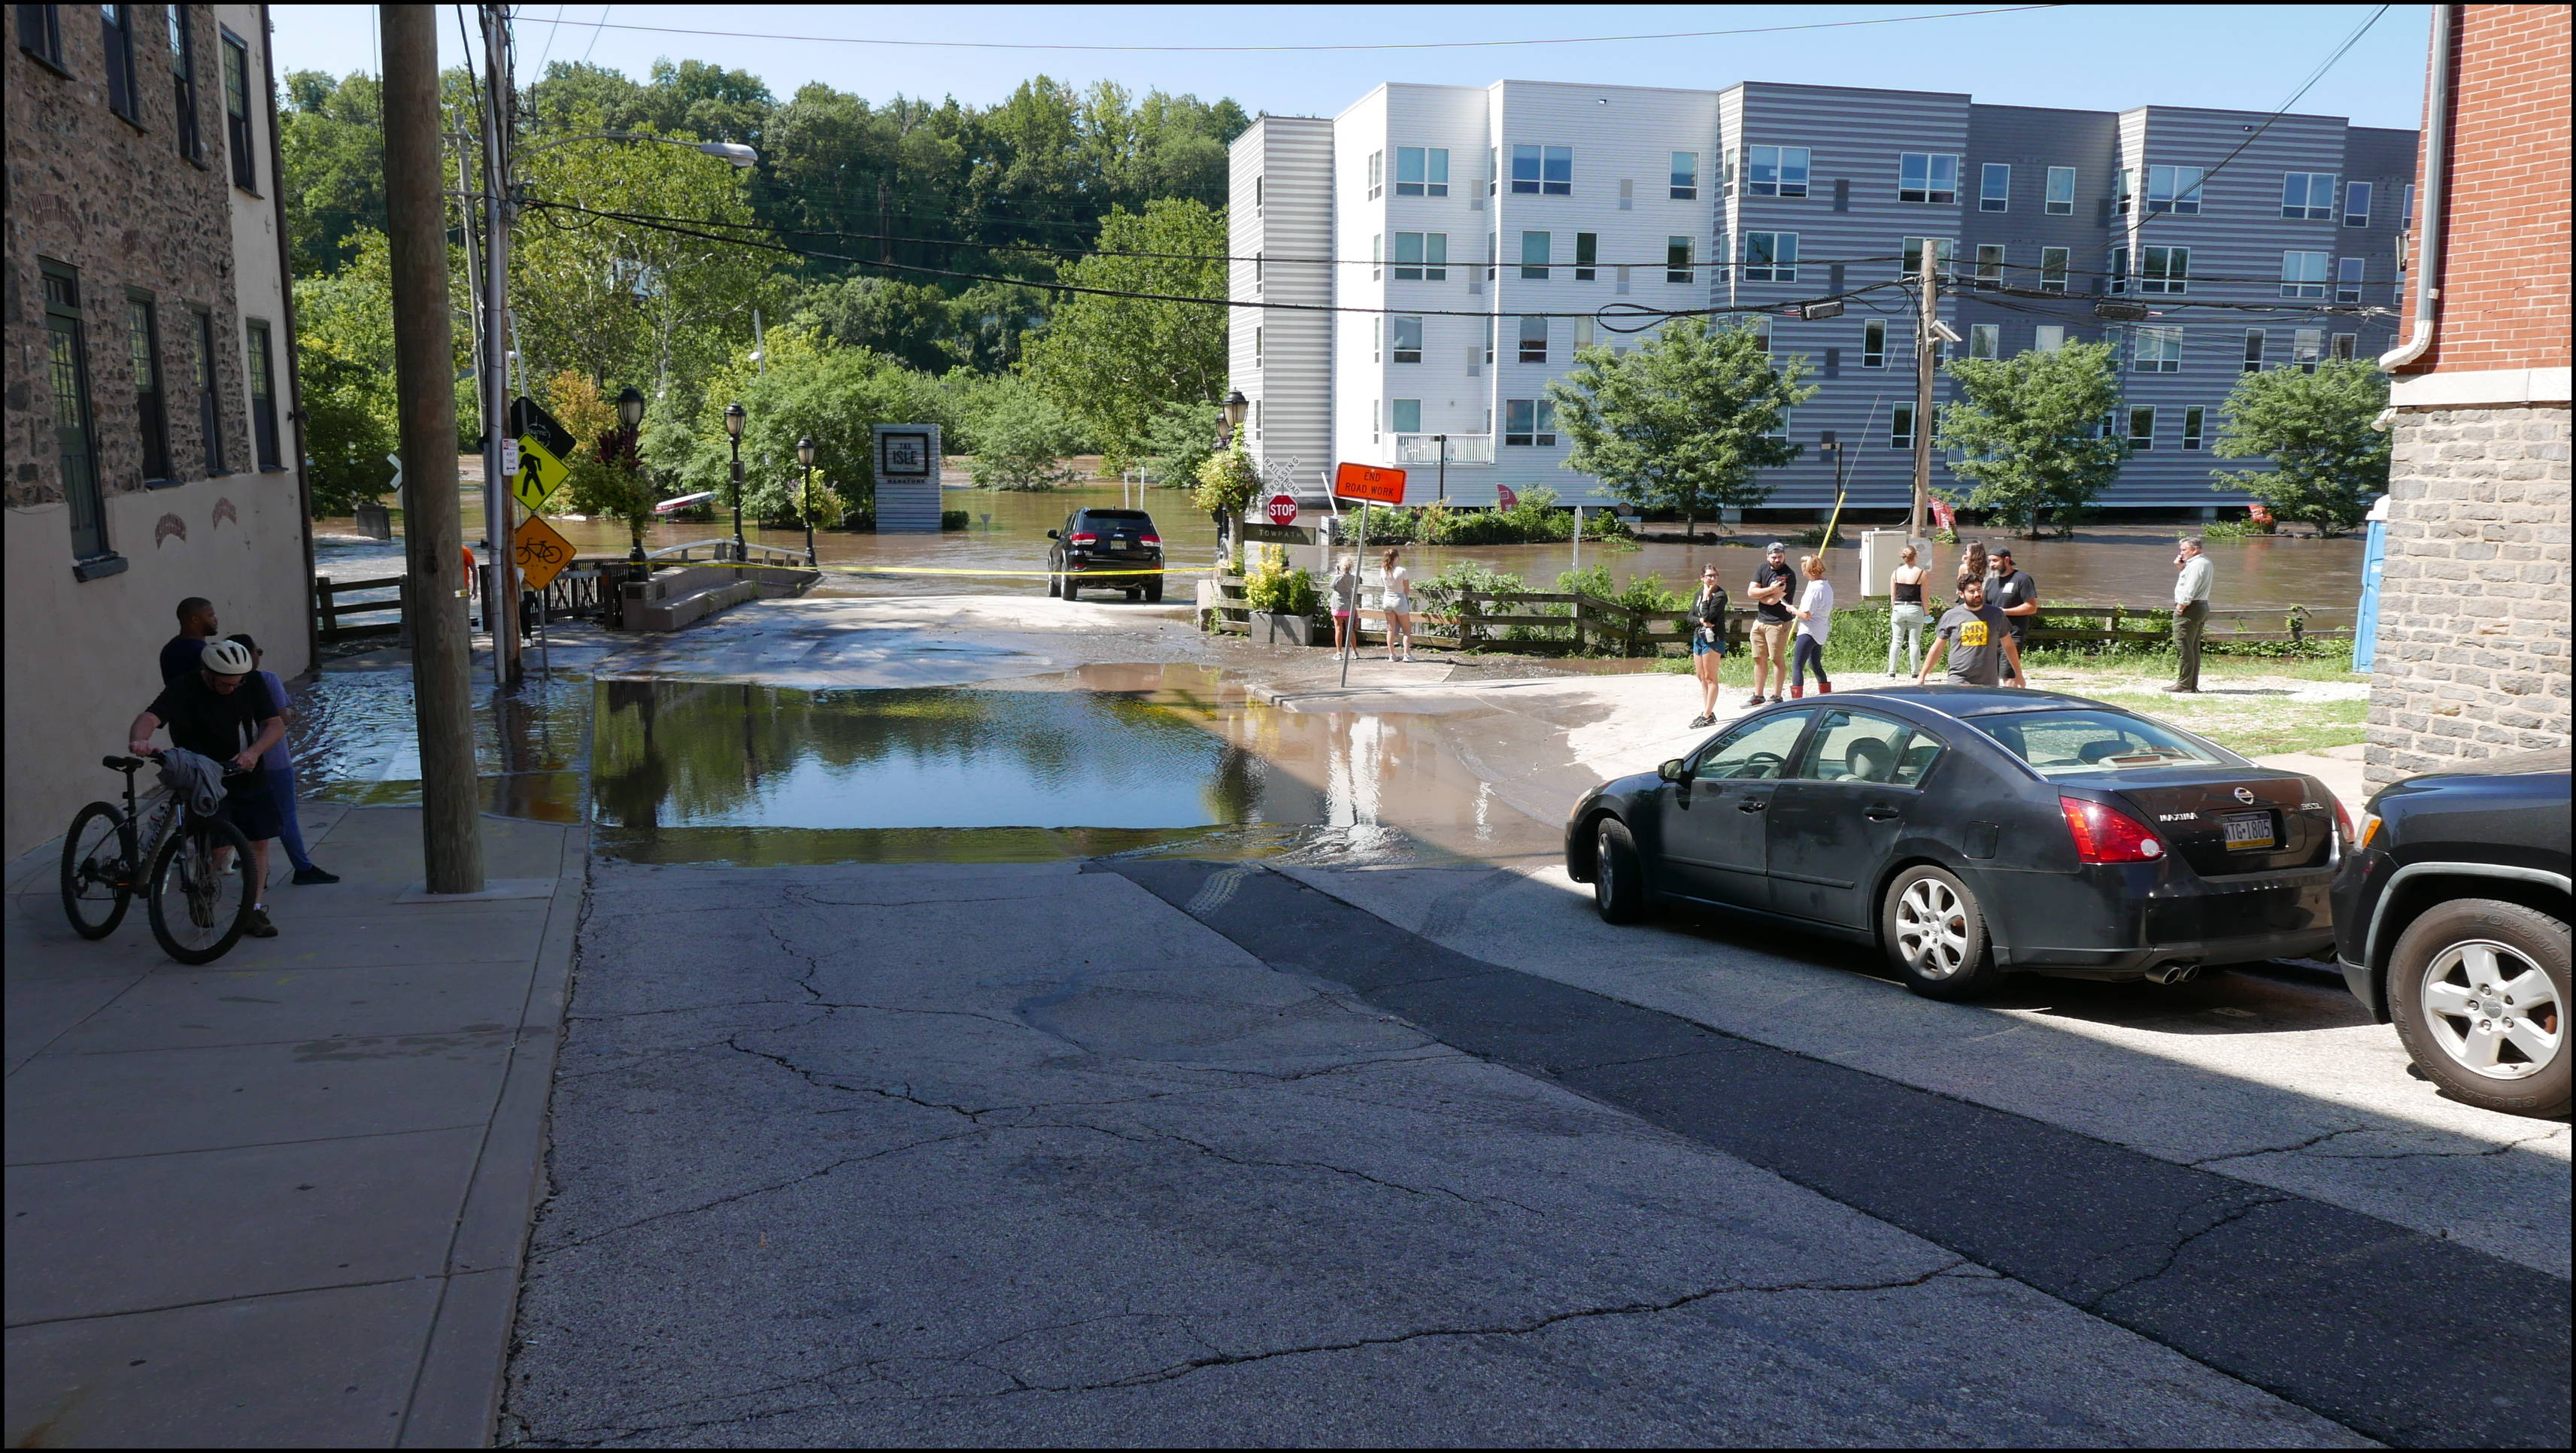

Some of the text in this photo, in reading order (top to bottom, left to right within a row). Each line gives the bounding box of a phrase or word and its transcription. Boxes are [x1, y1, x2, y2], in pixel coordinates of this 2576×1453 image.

[893, 450, 918, 465] ISLE
[1266, 457, 1299, 496] CROSSING
[1364, 472, 1381, 482] END
[1345, 482, 1394, 496] ROAD WORK
[1270, 504, 1296, 517] STOP
[1258, 529, 1302, 538] TOWPATH
[1965, 624, 1985, 634] MN
